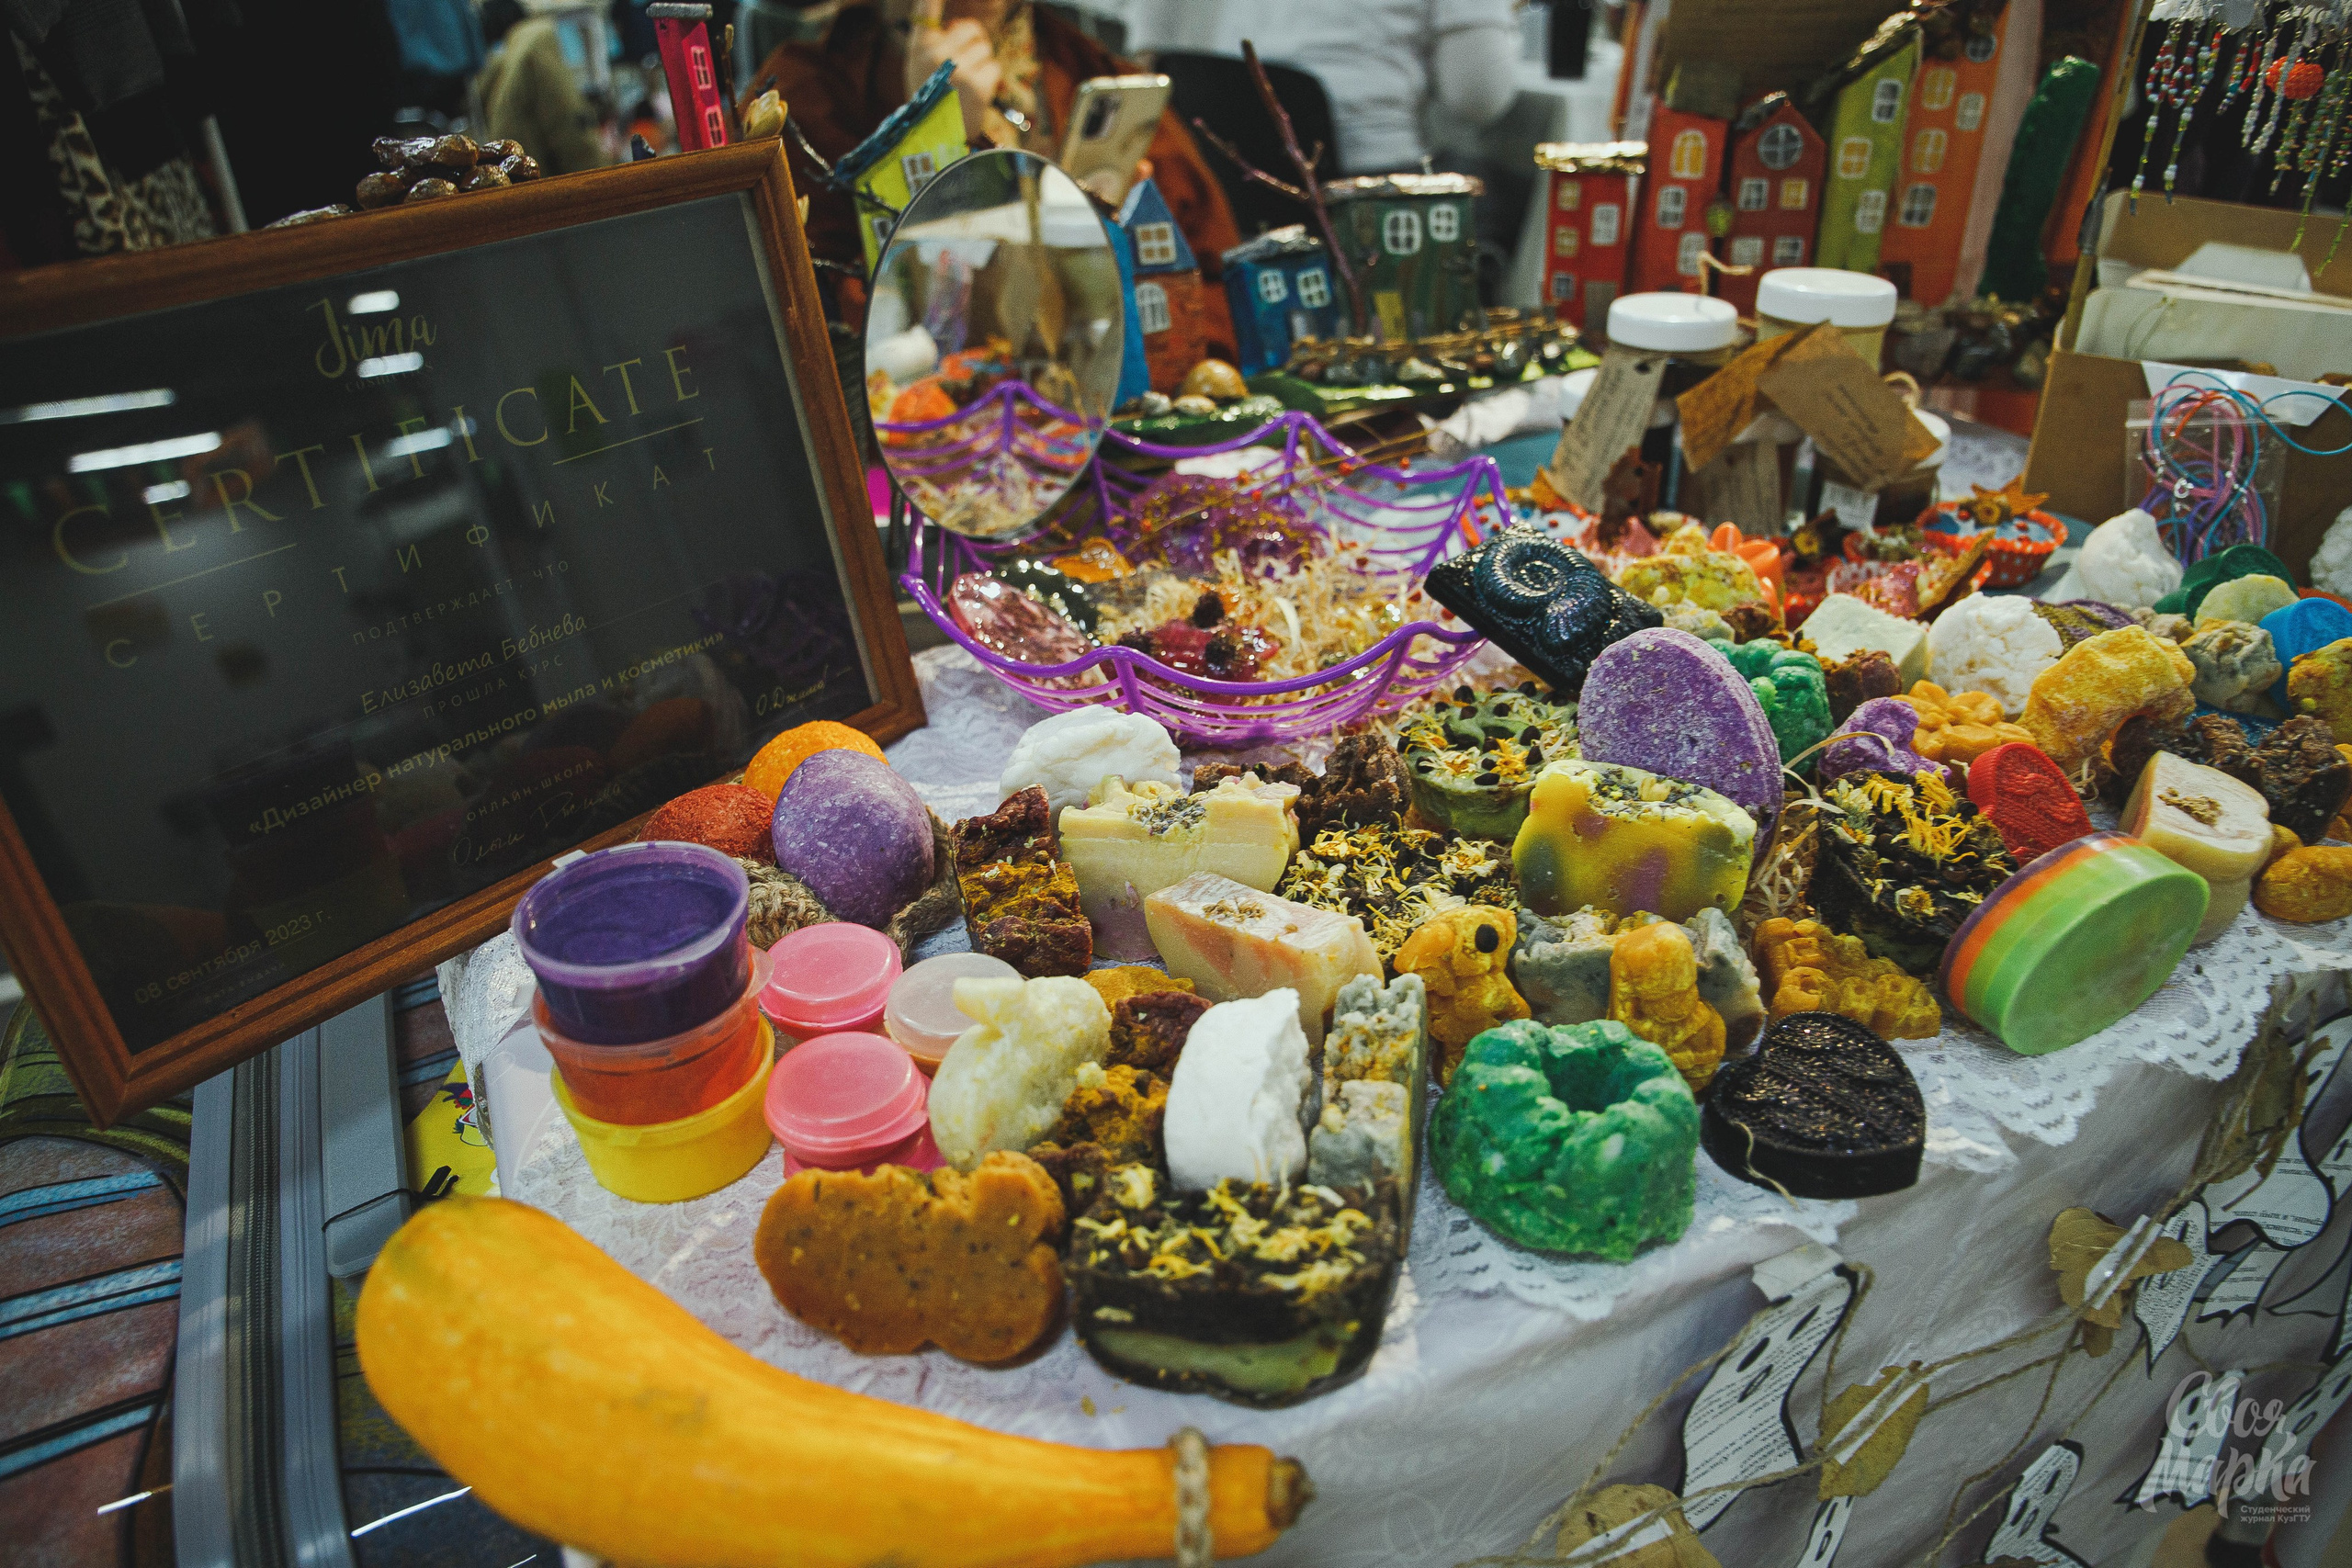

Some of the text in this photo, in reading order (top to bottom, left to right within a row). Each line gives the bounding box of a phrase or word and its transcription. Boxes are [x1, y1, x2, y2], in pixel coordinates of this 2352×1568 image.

[52, 344, 700, 575] CERTIFICATE
[104, 446, 716, 668] СЕРТИФИКАТ
[533, 559, 569, 580] ЧТО
[360, 612, 587, 715] Елизавета Бебнева
[423, 654, 563, 719] ПРОШЛА КУРС
[248, 631, 725, 834] «Дизайнер натурального мыла и косметики»
[466, 759, 594, 822] ОНЛАЙН-ШКОЛА
[134, 980, 163, 1004] 08
[165, 938, 263, 991] сентября
[264, 914, 312, 948] 2023
